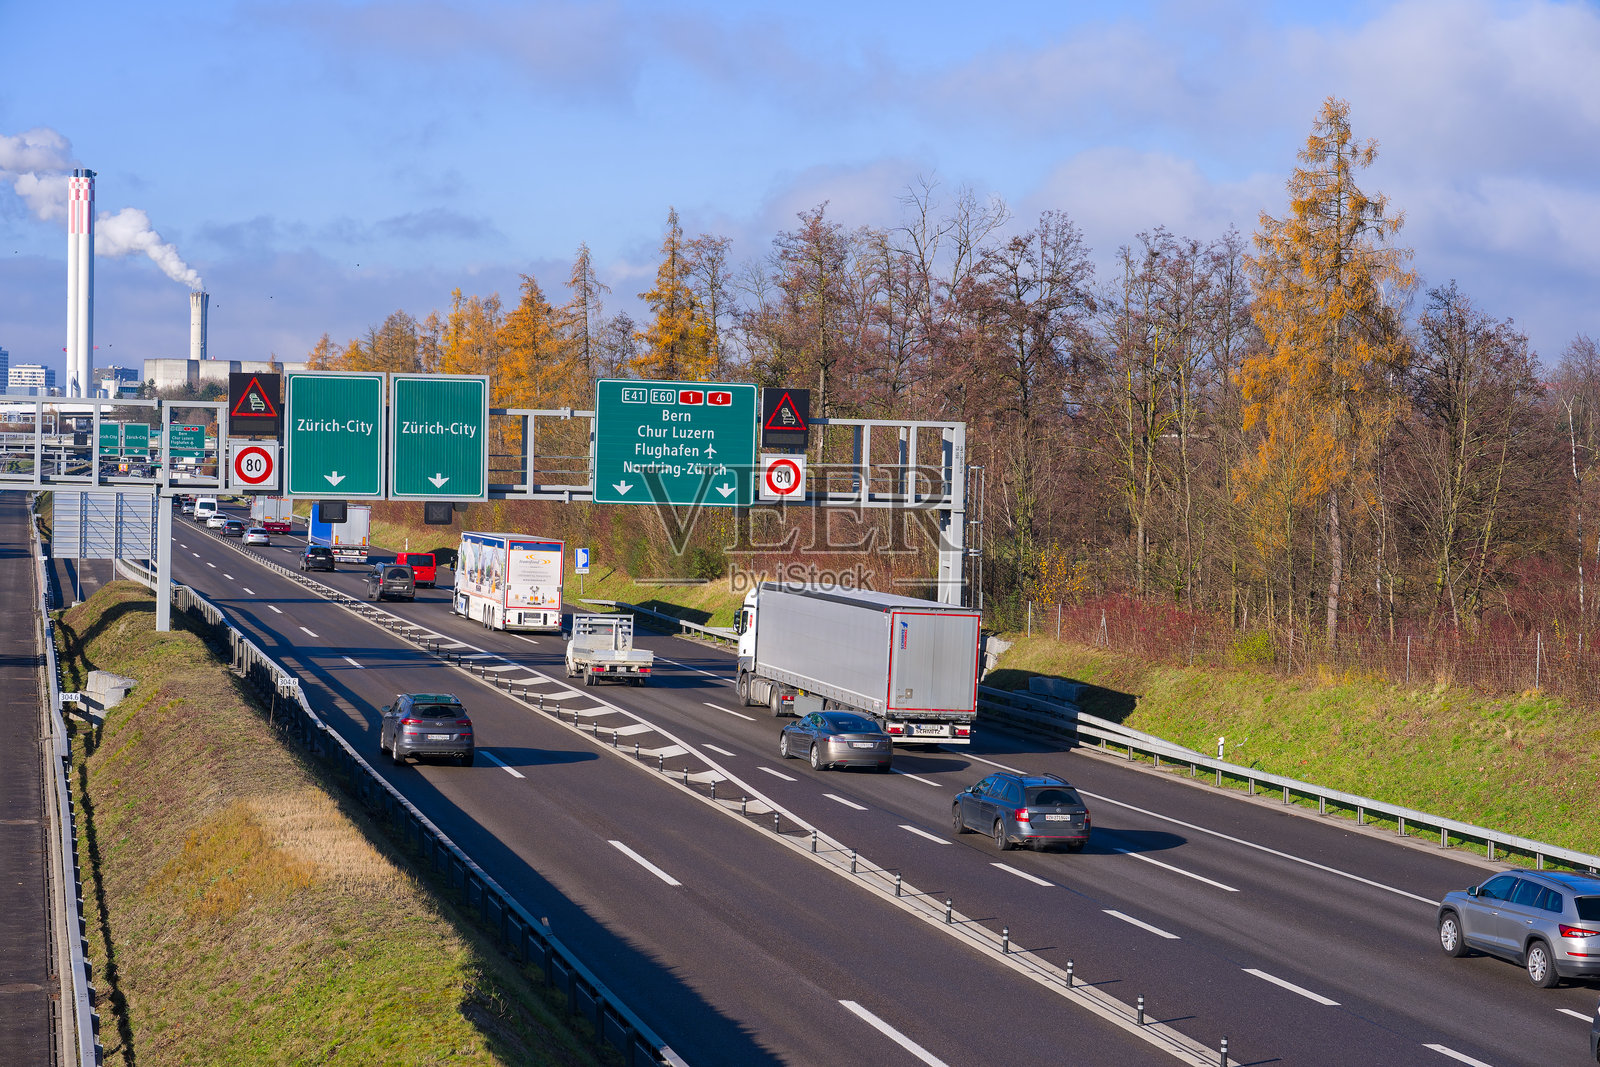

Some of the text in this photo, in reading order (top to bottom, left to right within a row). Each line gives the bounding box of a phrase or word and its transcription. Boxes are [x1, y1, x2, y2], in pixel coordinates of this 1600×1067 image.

[624, 390, 722, 404] E41 E60 1 4
[662, 409, 692, 422] Bern
[296, 418, 374, 436] Zürich-City
[402, 422, 477, 438] Zürich-City
[638, 424, 714, 440] Chur Luzern
[635, 442, 700, 458] Flughafen
[246, 458, 262, 472] 80
[623, 460, 727, 478] Nordring-Zürich
[776, 470, 791, 484] 80
